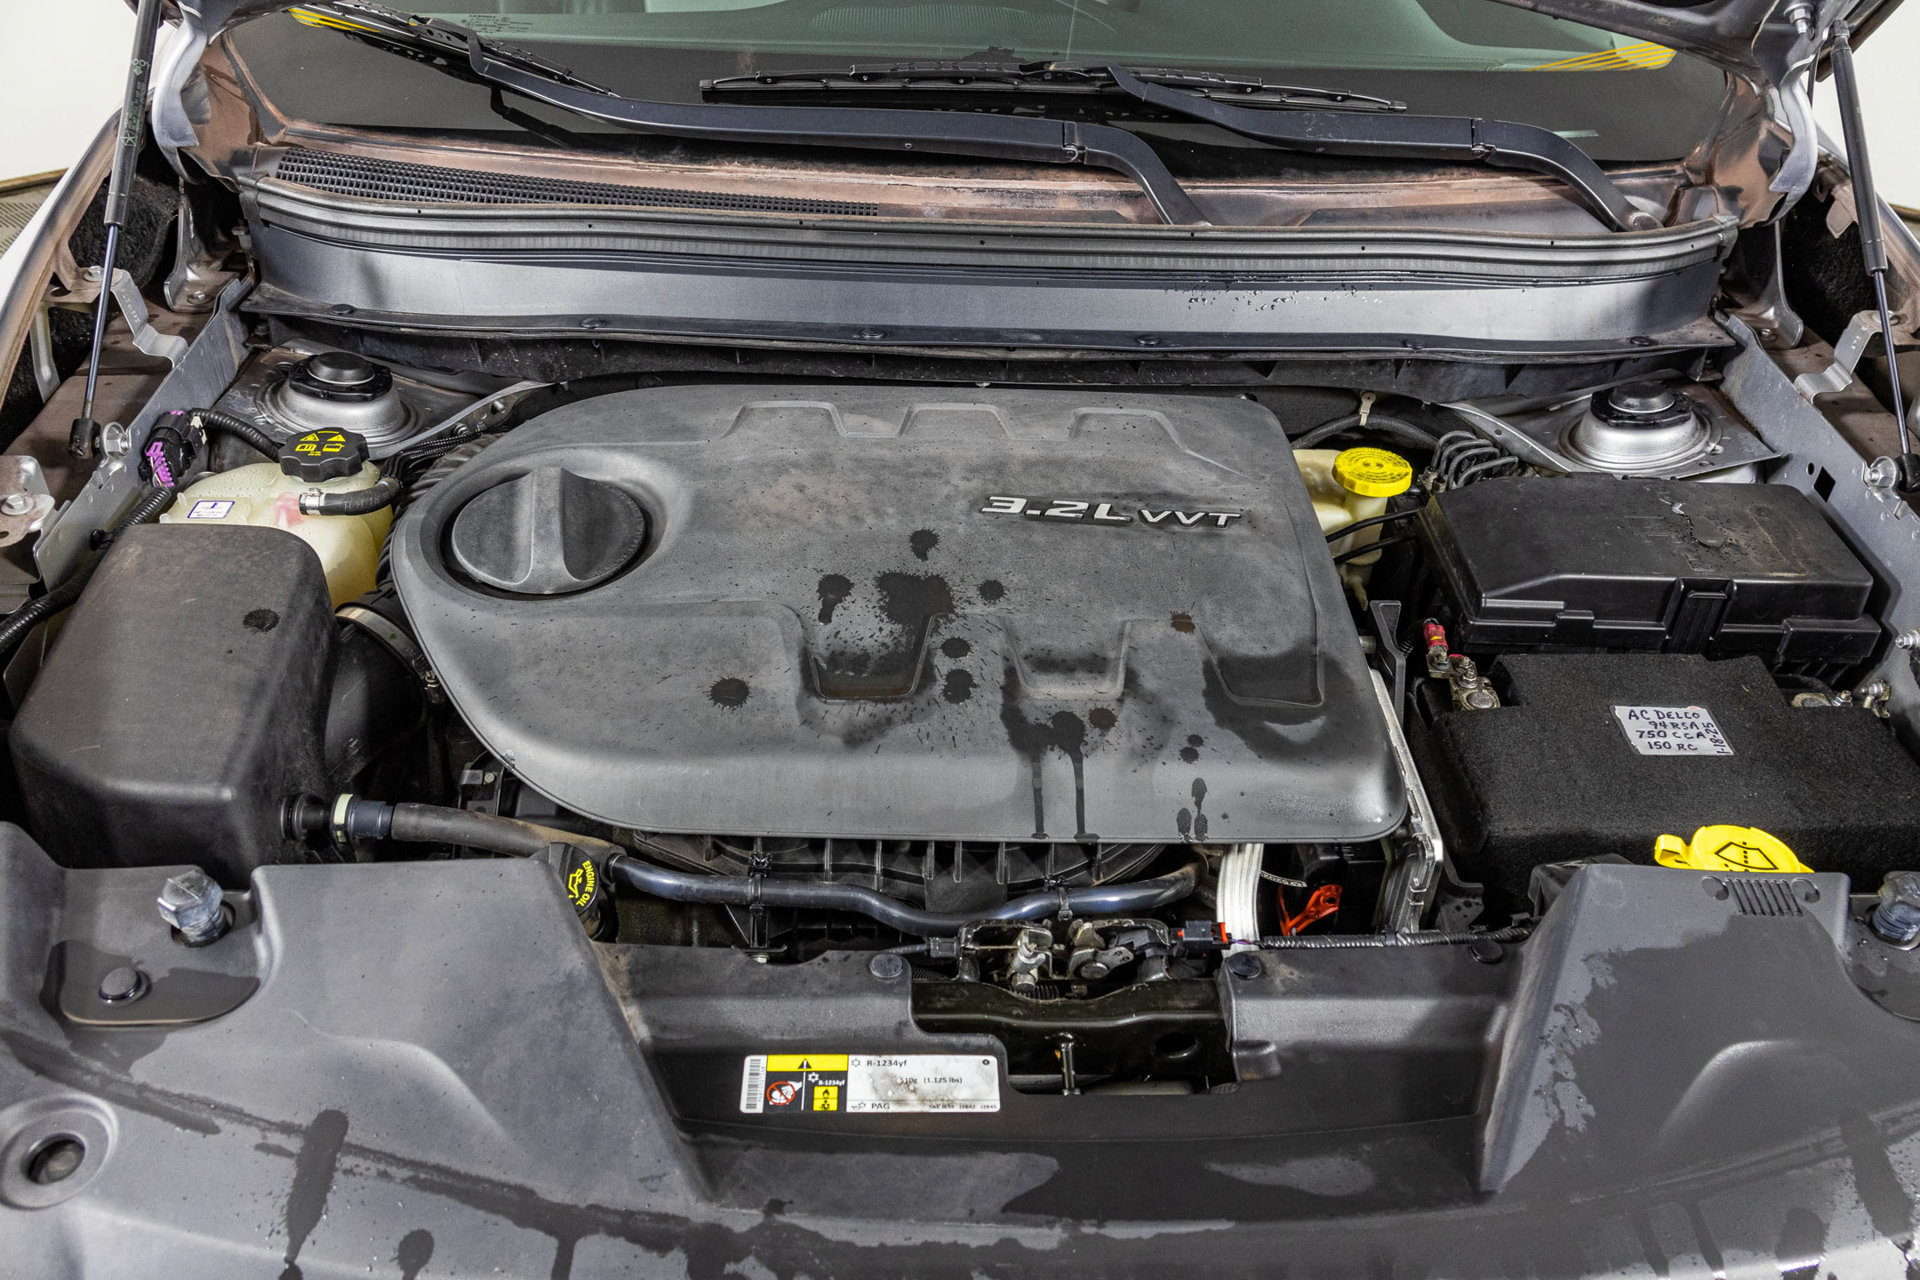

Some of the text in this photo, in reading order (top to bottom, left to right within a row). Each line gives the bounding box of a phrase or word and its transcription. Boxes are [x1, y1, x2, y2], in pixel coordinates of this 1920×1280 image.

[981, 496, 1242, 528] 3.2L VVT
[1628, 709, 1700, 720] AC DELCO
[1635, 730, 1707, 740] 750 CCA
[1647, 741, 1698, 751] 150 RC
[576, 860, 596, 907] ENGINE OIL
[866, 1059, 907, 1068] R-1234yf
[948, 1077, 963, 1085] lbs)
[870, 1102, 891, 1110] PAG
